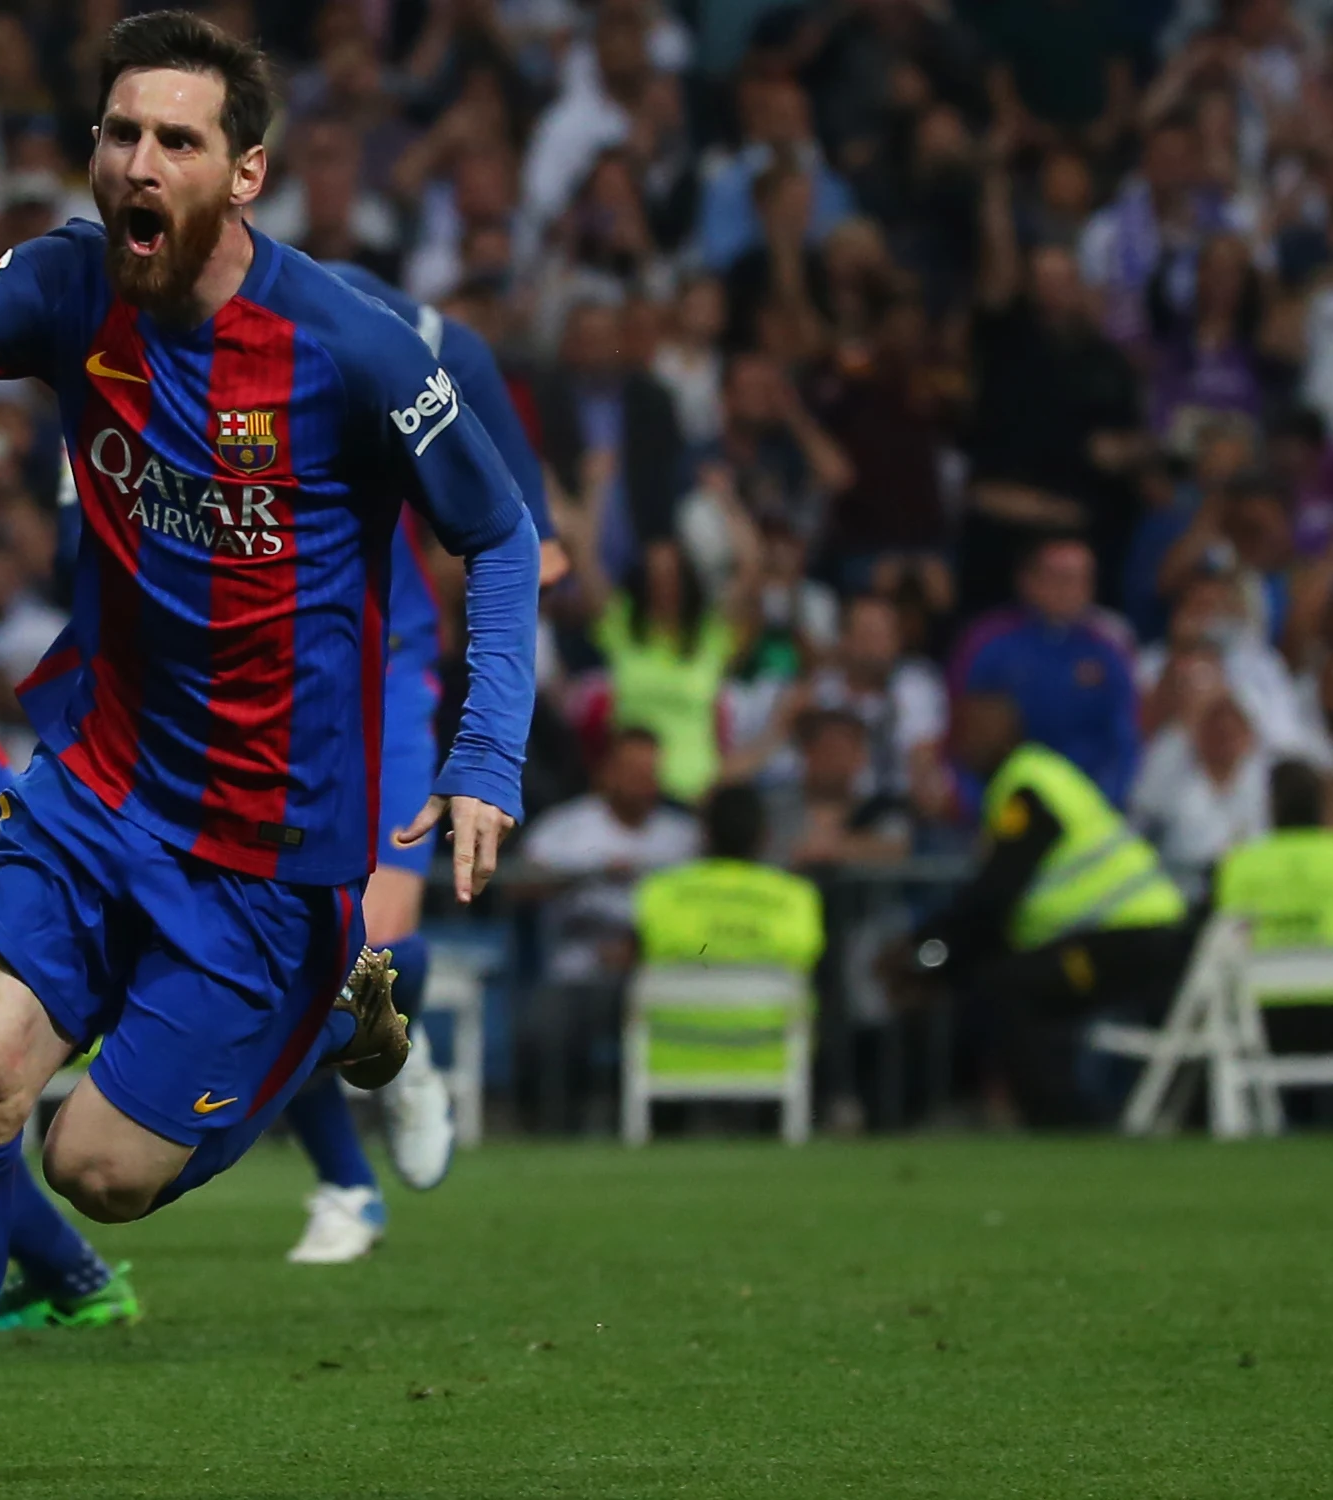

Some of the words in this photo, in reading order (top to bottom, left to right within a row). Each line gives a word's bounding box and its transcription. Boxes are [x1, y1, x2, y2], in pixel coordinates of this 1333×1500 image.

[389, 367, 452, 435] beko
[91, 427, 279, 526] QATAR
[127, 495, 283, 556] AIRWAYS
